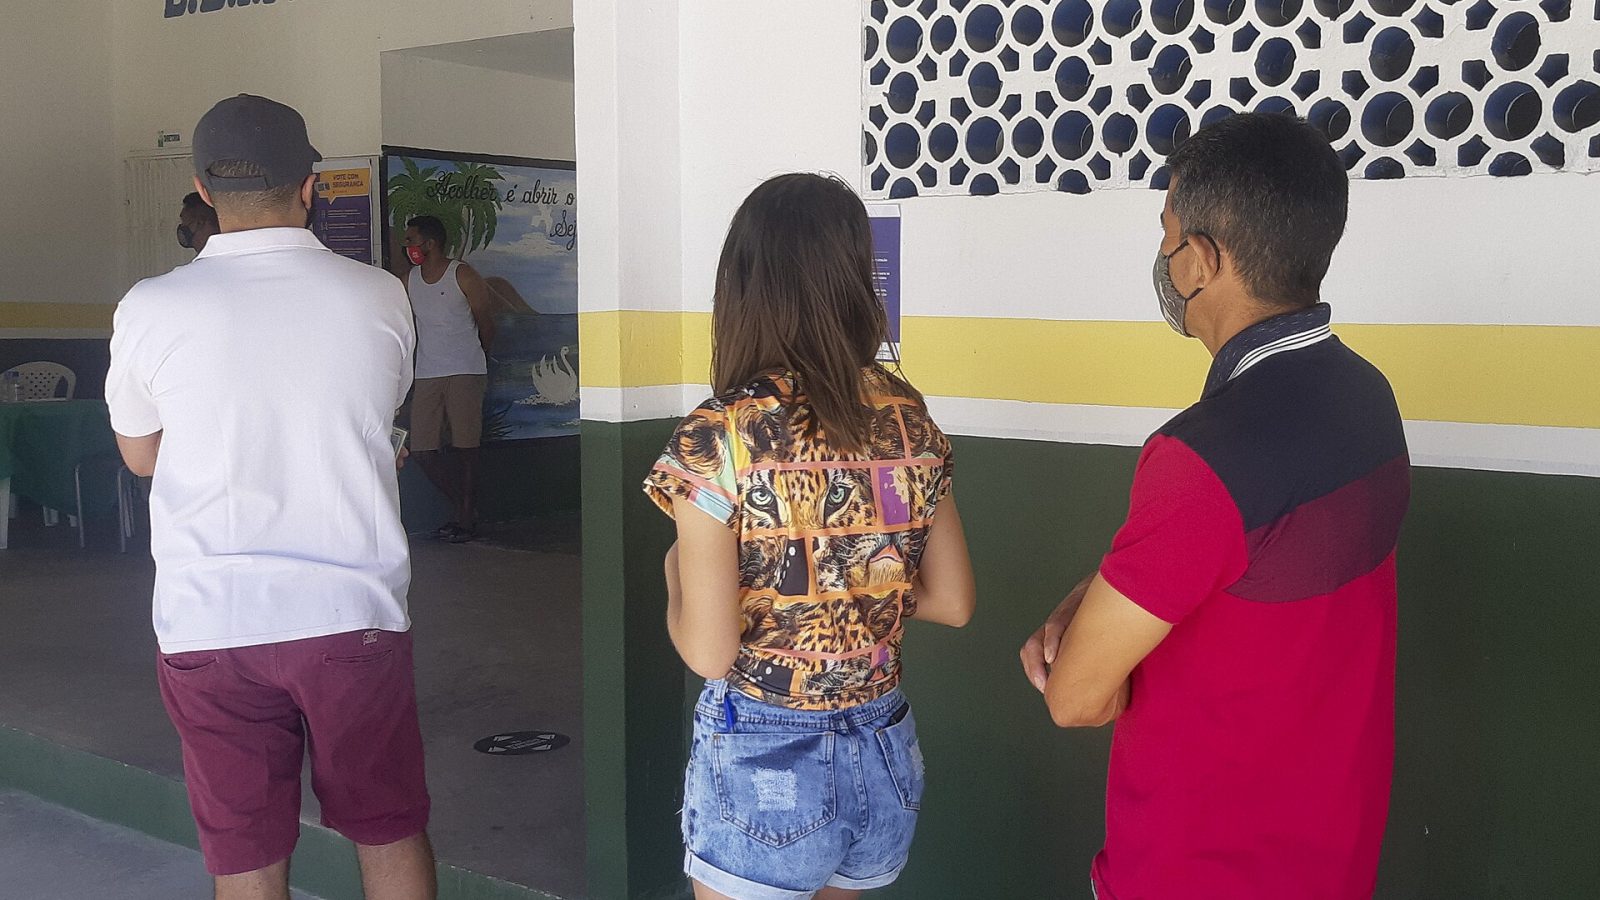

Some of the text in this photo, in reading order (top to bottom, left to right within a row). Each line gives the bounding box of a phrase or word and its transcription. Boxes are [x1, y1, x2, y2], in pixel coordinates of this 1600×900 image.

[427, 170, 575, 206] Acolher é abrir o
